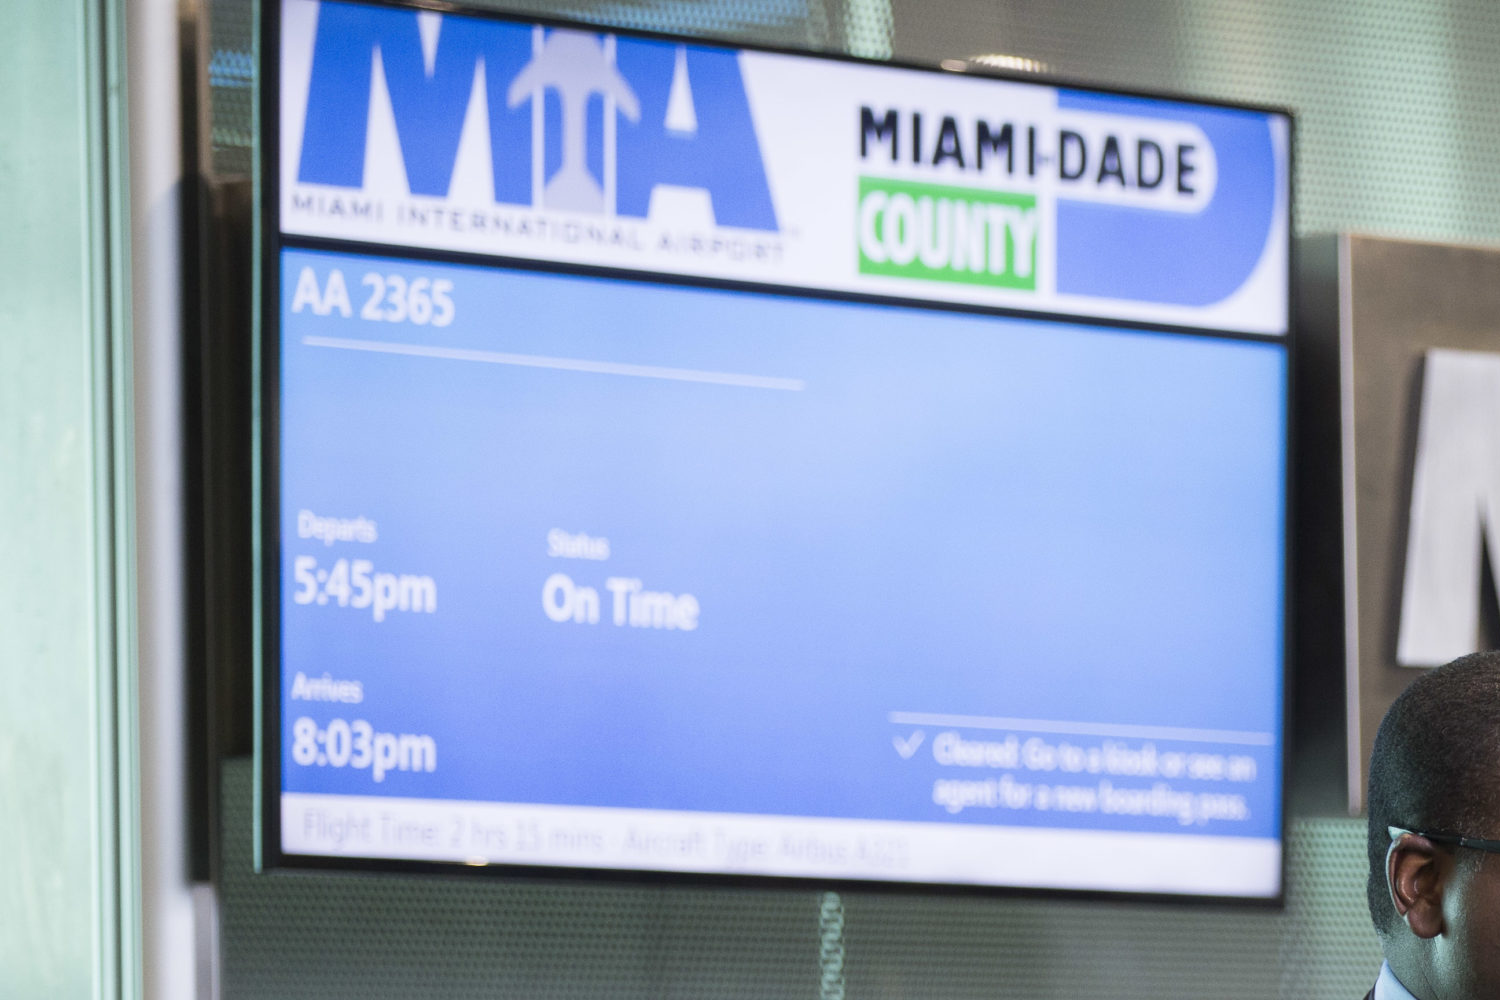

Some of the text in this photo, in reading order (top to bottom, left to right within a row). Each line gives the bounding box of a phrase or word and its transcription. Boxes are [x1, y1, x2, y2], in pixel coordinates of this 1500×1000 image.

[291, 194, 784, 264] MIAMI INTERNATIONAL AIRPORT
[859, 190, 1036, 279] COUNTY
[292, 266, 455, 327] AA 2365
[297, 509, 377, 546] Departs
[548, 528, 610, 561] Status
[294, 555, 437, 623] 5:45pm
[542, 573, 699, 631] On Time
[292, 671, 363, 704] Arrives
[292, 716, 437, 783] 8:03pm
